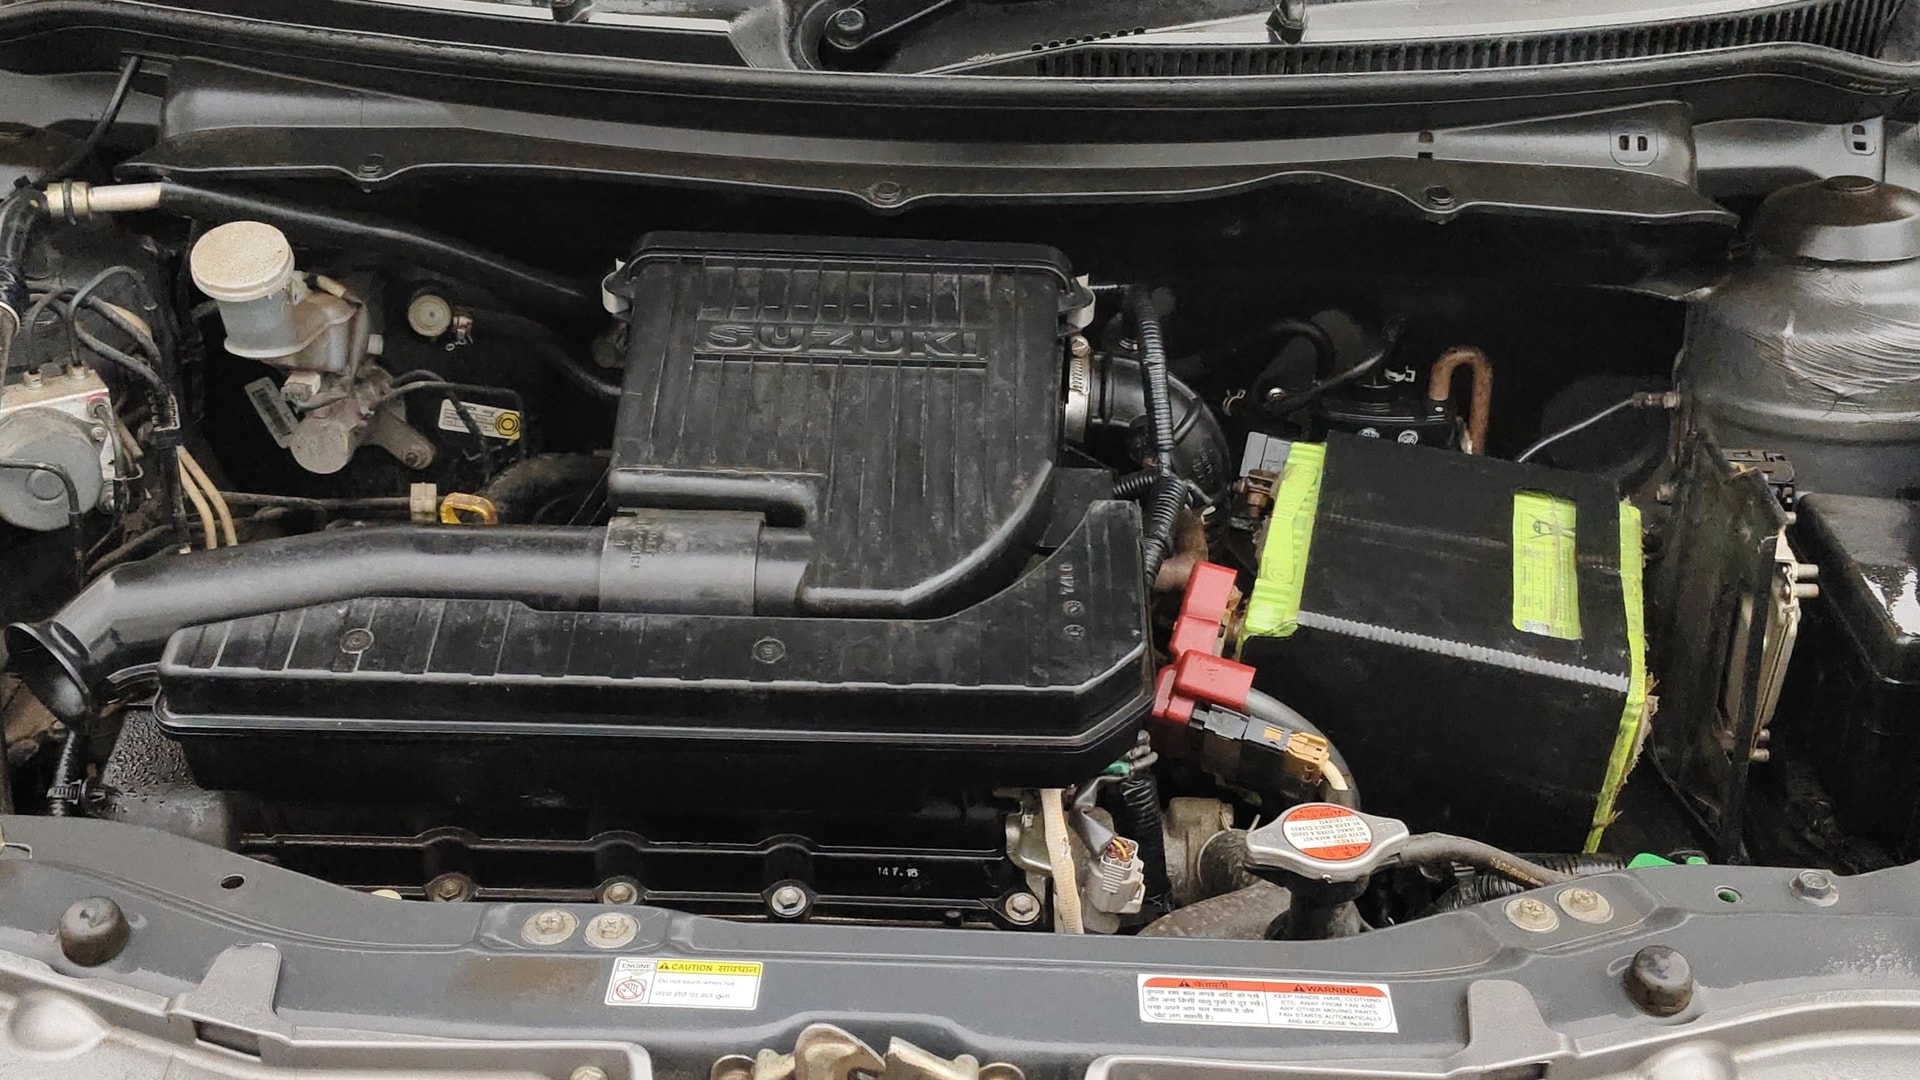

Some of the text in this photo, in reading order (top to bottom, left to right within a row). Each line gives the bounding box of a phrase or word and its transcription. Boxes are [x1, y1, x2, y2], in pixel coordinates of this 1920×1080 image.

[705, 324, 980, 357] SUZUKI
[621, 962, 652, 970] ENGINE
[671, 963, 758, 974] CAUTION सावधान
[1307, 985, 1359, 995] WARNING
